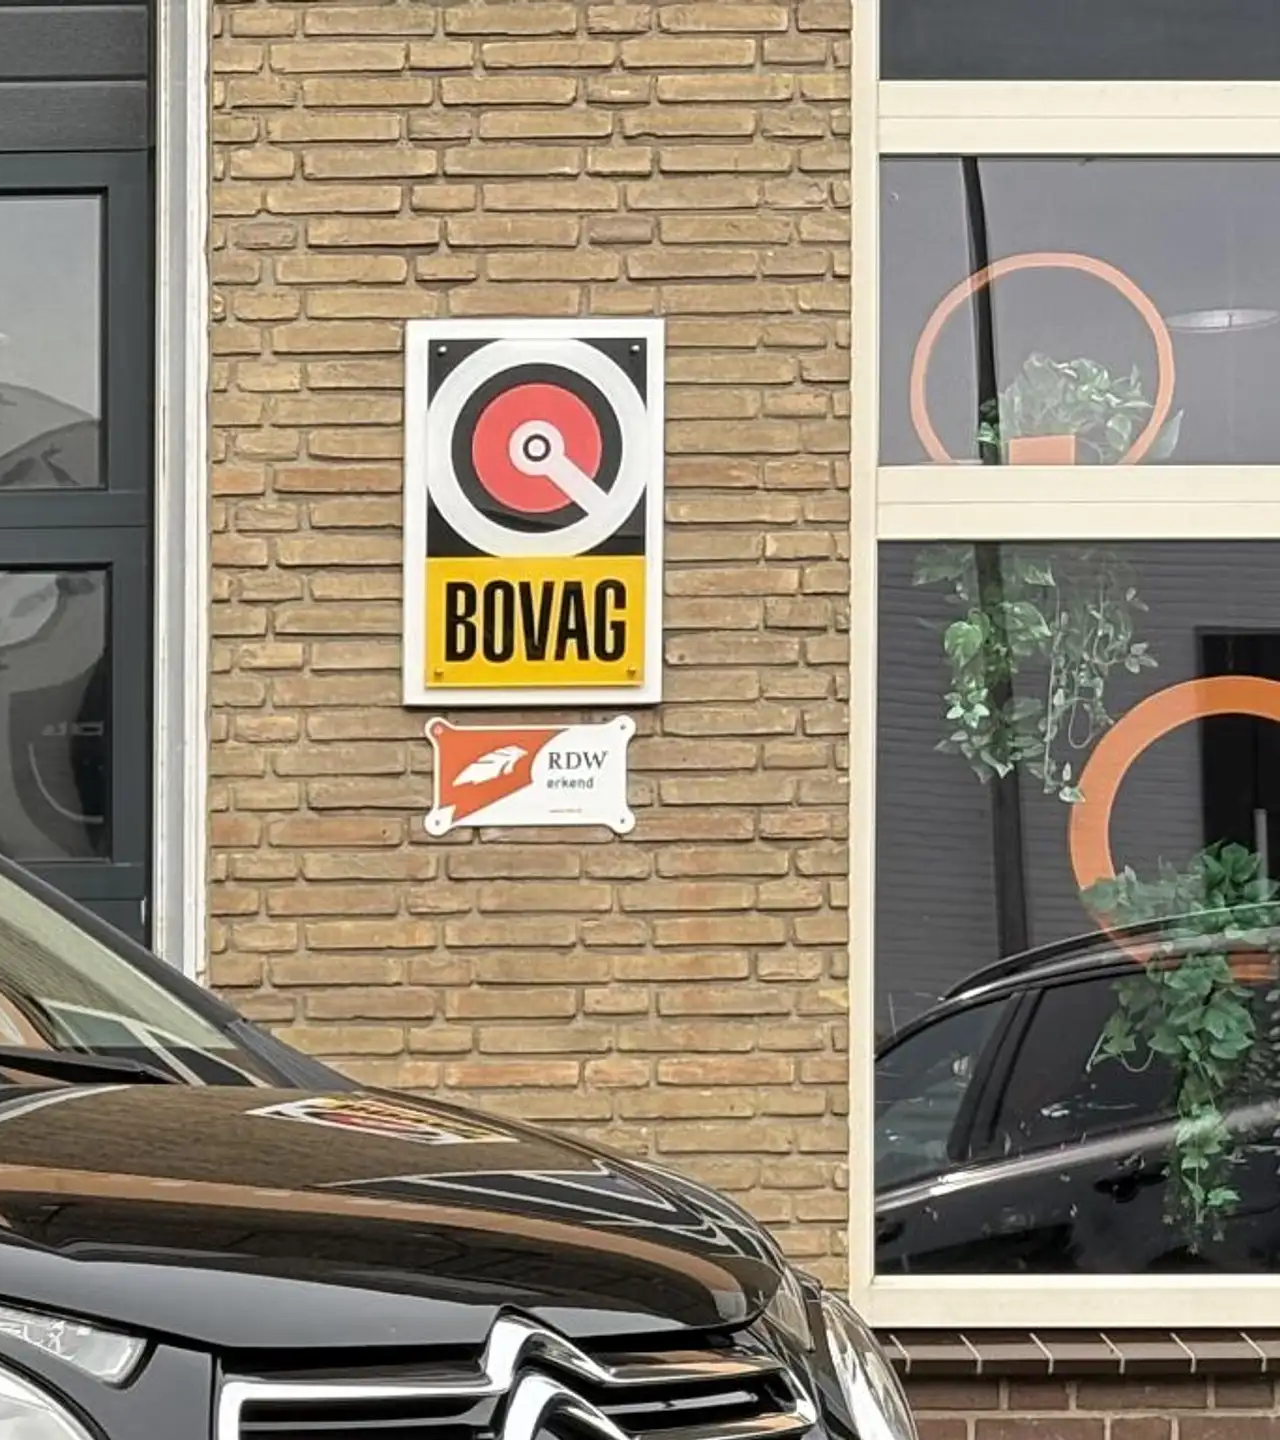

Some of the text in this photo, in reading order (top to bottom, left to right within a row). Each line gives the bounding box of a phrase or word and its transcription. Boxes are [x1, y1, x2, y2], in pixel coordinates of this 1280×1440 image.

[444, 579, 627, 663] BOVAG
[547, 750, 608, 770] RDW
[546, 776, 594, 789] erkend
